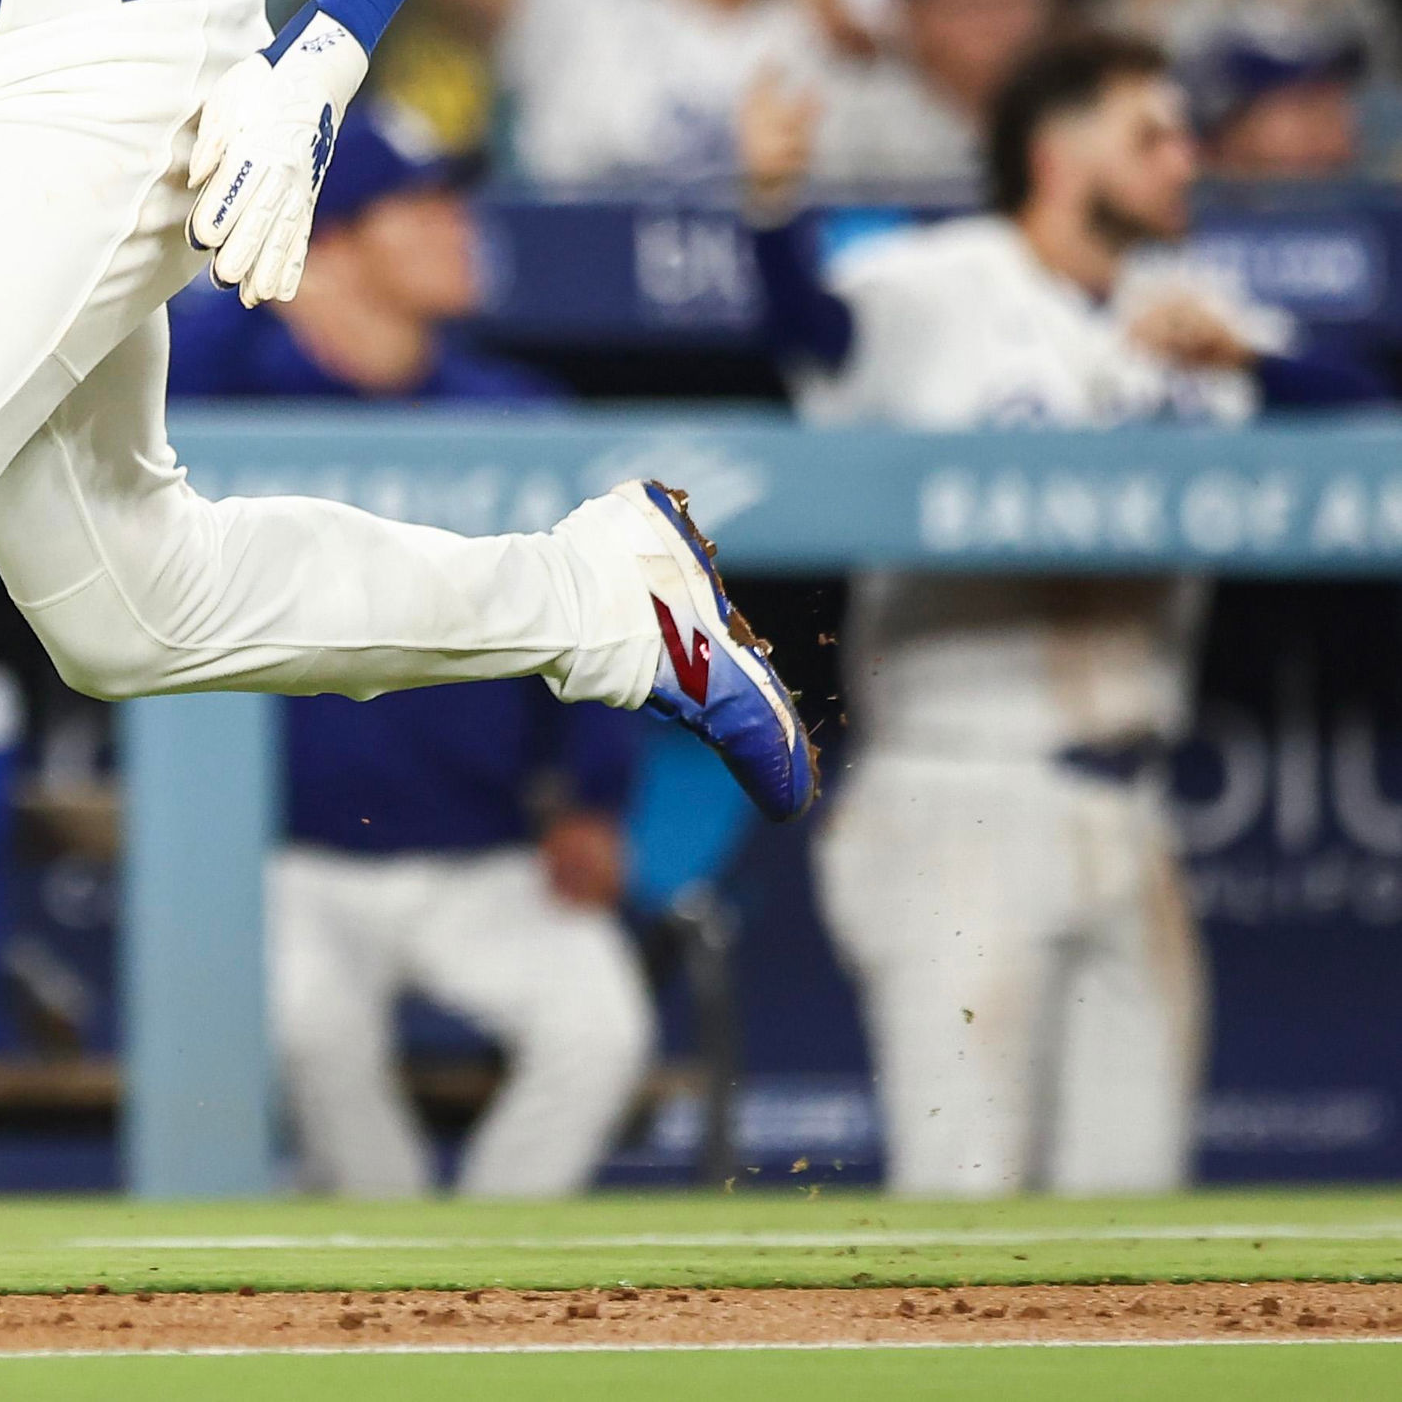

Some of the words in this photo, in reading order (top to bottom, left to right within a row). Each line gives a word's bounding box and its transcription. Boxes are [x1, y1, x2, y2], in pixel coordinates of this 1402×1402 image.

[212, 204, 228, 229] new
[223, 160, 252, 205] balance
[919, 467, 1165, 553] BANK
[1180, 467, 1294, 554] OF
